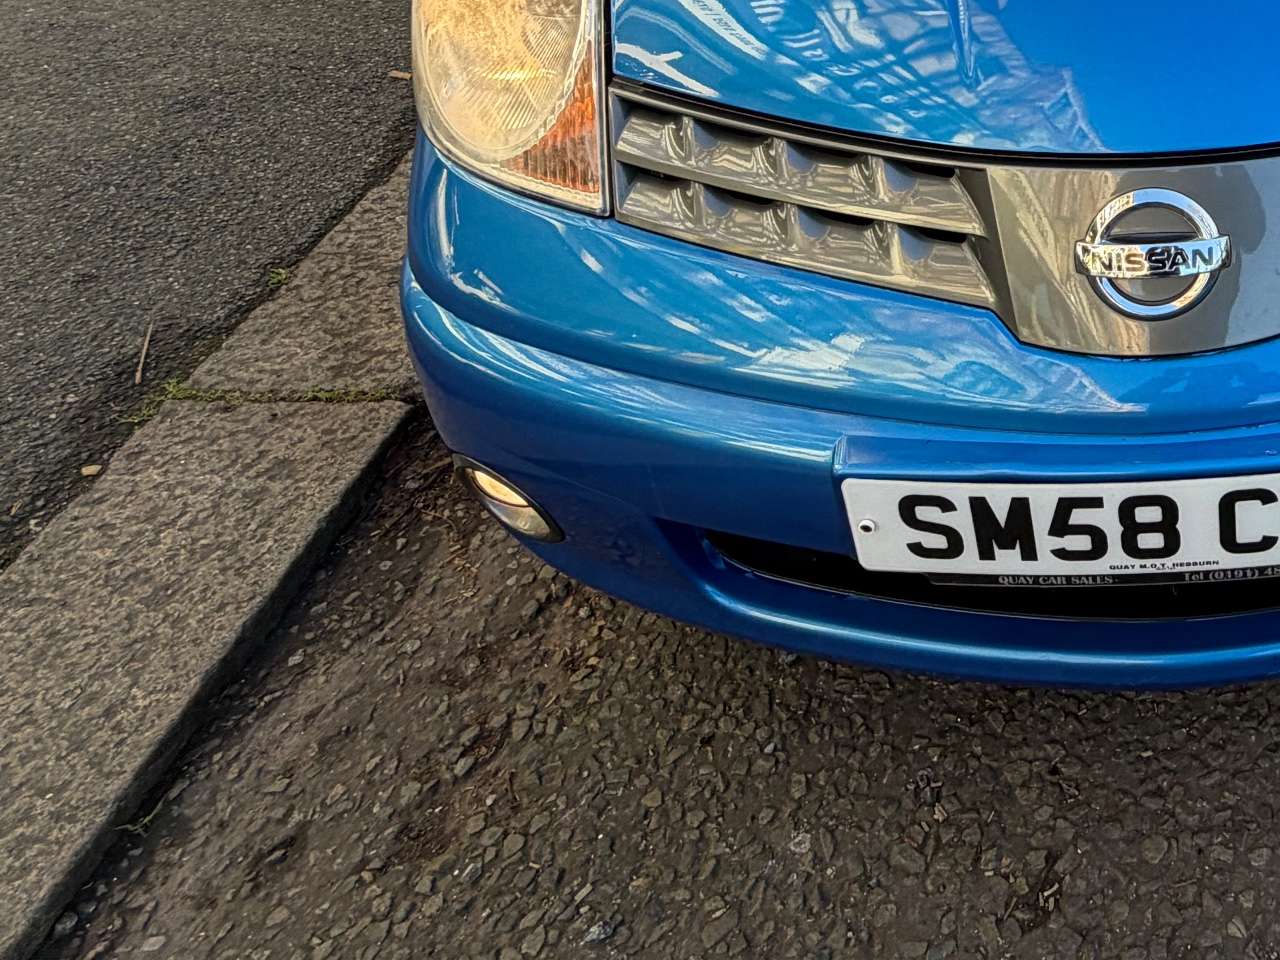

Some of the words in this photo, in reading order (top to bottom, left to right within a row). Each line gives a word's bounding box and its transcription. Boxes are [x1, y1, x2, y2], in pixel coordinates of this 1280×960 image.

[1090, 246, 1214, 272] NISSAN
[899, 493, 1181, 563] SM58
[1108, 563, 1136, 571] QUAY
[998, 575, 1034, 586] QUAY
[1038, 575, 1067, 585] CAR
[1071, 574, 1113, 585] SALES
